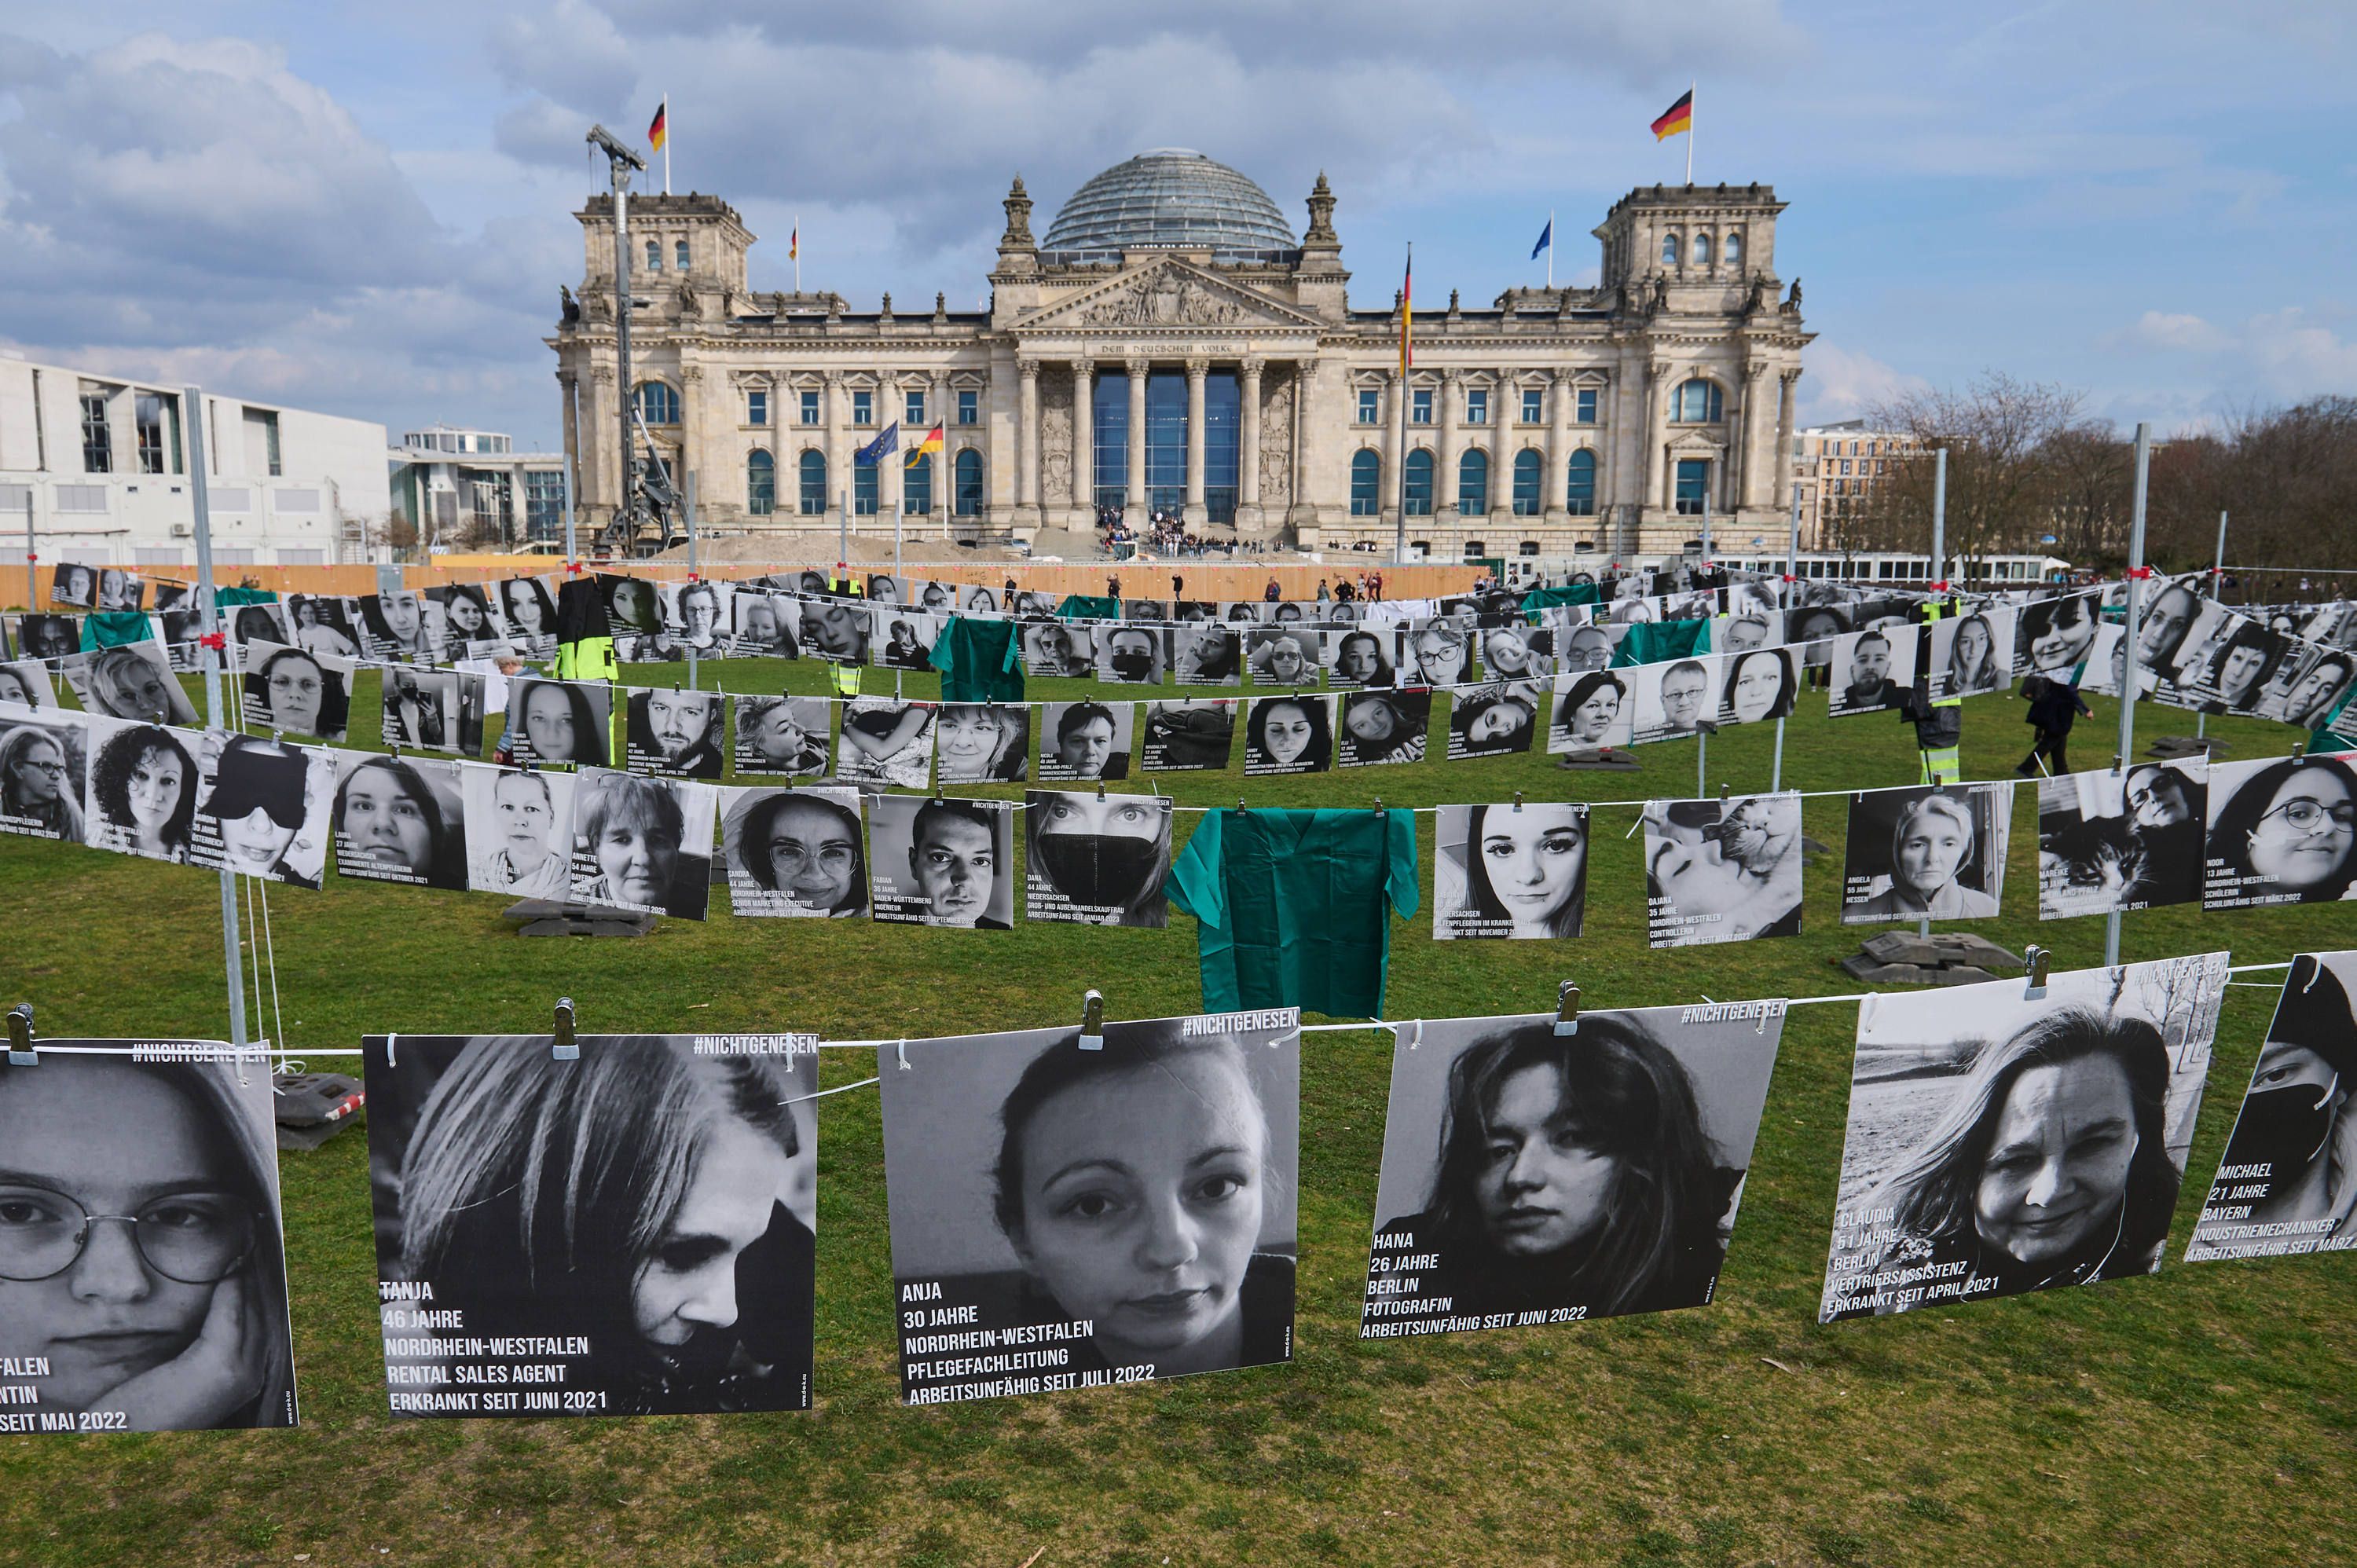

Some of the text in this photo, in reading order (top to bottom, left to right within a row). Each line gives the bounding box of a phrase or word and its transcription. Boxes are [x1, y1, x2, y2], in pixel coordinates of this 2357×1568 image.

[572, 852, 597, 863] ANNETTE
[580, 864, 597, 874] JAHRE
[2040, 868, 2069, 878] MAREIKE
[2216, 868, 2236, 877] JAHRE
[2205, 874, 2278, 888] NORDRHEIN-WESTFALEN
[874, 894, 932, 904] BADEN-WÜRTTEMBERG
[1027, 893, 1069, 902] NIEDERSACHSEN
[1648, 896, 1672, 906] DAJANA
[2205, 888, 2239, 898] SCHÜLERIN
[651, 906, 666, 915] 2022
[1649, 907, 1677, 917] 35 JAHRE
[2131, 901, 2148, 910] 2021
[874, 912, 918, 921] ARBEITSUNFÄHIG
[1027, 911, 1071, 921] ARBEITSUNFÄHIG
[1649, 913, 1722, 928] NORDRHEIN-WESTFALEN
[1182, 1010, 1297, 1036] #NICHTGENESEN
[132, 1044, 266, 1063] #NICHTGENEEN
[2217, 1163, 2272, 1179] MICHAEL
[2209, 1184, 2270, 1201] 21 JAHRE
[1841, 1207, 1895, 1228] CLAUDIA
[2202, 1206, 2252, 1222] BAYERN
[2193, 1218, 2336, 1242] INDUSTRIEMECHANIKER
[1373, 1233, 1413, 1249] HANA
[1837, 1229, 1898, 1250] 51 JAHRE
[2186, 1240, 2289, 1262] ARBEITSUNFÄHIG
[2289, 1240, 2318, 1254] SEIT
[2318, 1235, 2354, 1251] MÄRZ
[1370, 1254, 1439, 1273] 26 JAHRE
[1833, 1252, 1880, 1271] BERLIN
[1831, 1261, 1968, 1292] VERTRIEBSASSISTENZ
[380, 1281, 433, 1300] TANJA
[902, 1282, 942, 1302] ANJA
[1367, 1277, 1419, 1295] BERLIN
[1827, 1276, 2000, 1313] ERKRANKT SEIT APRIL 2021
[1364, 1297, 1452, 1317] FOTOGRAFIN
[383, 1310, 463, 1328] 46 JAHRE
[904, 1306, 978, 1328] 30 JAHRE
[1361, 1306, 1587, 1339] ARBEITSUNFÄHIG SEIT JUNI 2022
[906, 1320, 1093, 1354] NORDRHEIN-WESTFALEN
[385, 1337, 588, 1356] NORDRHEIN-WESTFALEN
[0, 1357, 50, 1376] ALEN
[907, 1349, 1069, 1380] PFLEGEFACHLEITUNG
[387, 1365, 566, 1383] RENTAL SALES AGENT
[910, 1364, 1156, 1405] ARBEITSUNFÄHIG SEIT JULI 2022
[390, 1390, 607, 1411] ERKRANKT SEIT JUNI 2021
[0, 1412, 127, 1432] SEIT MAI 2022
